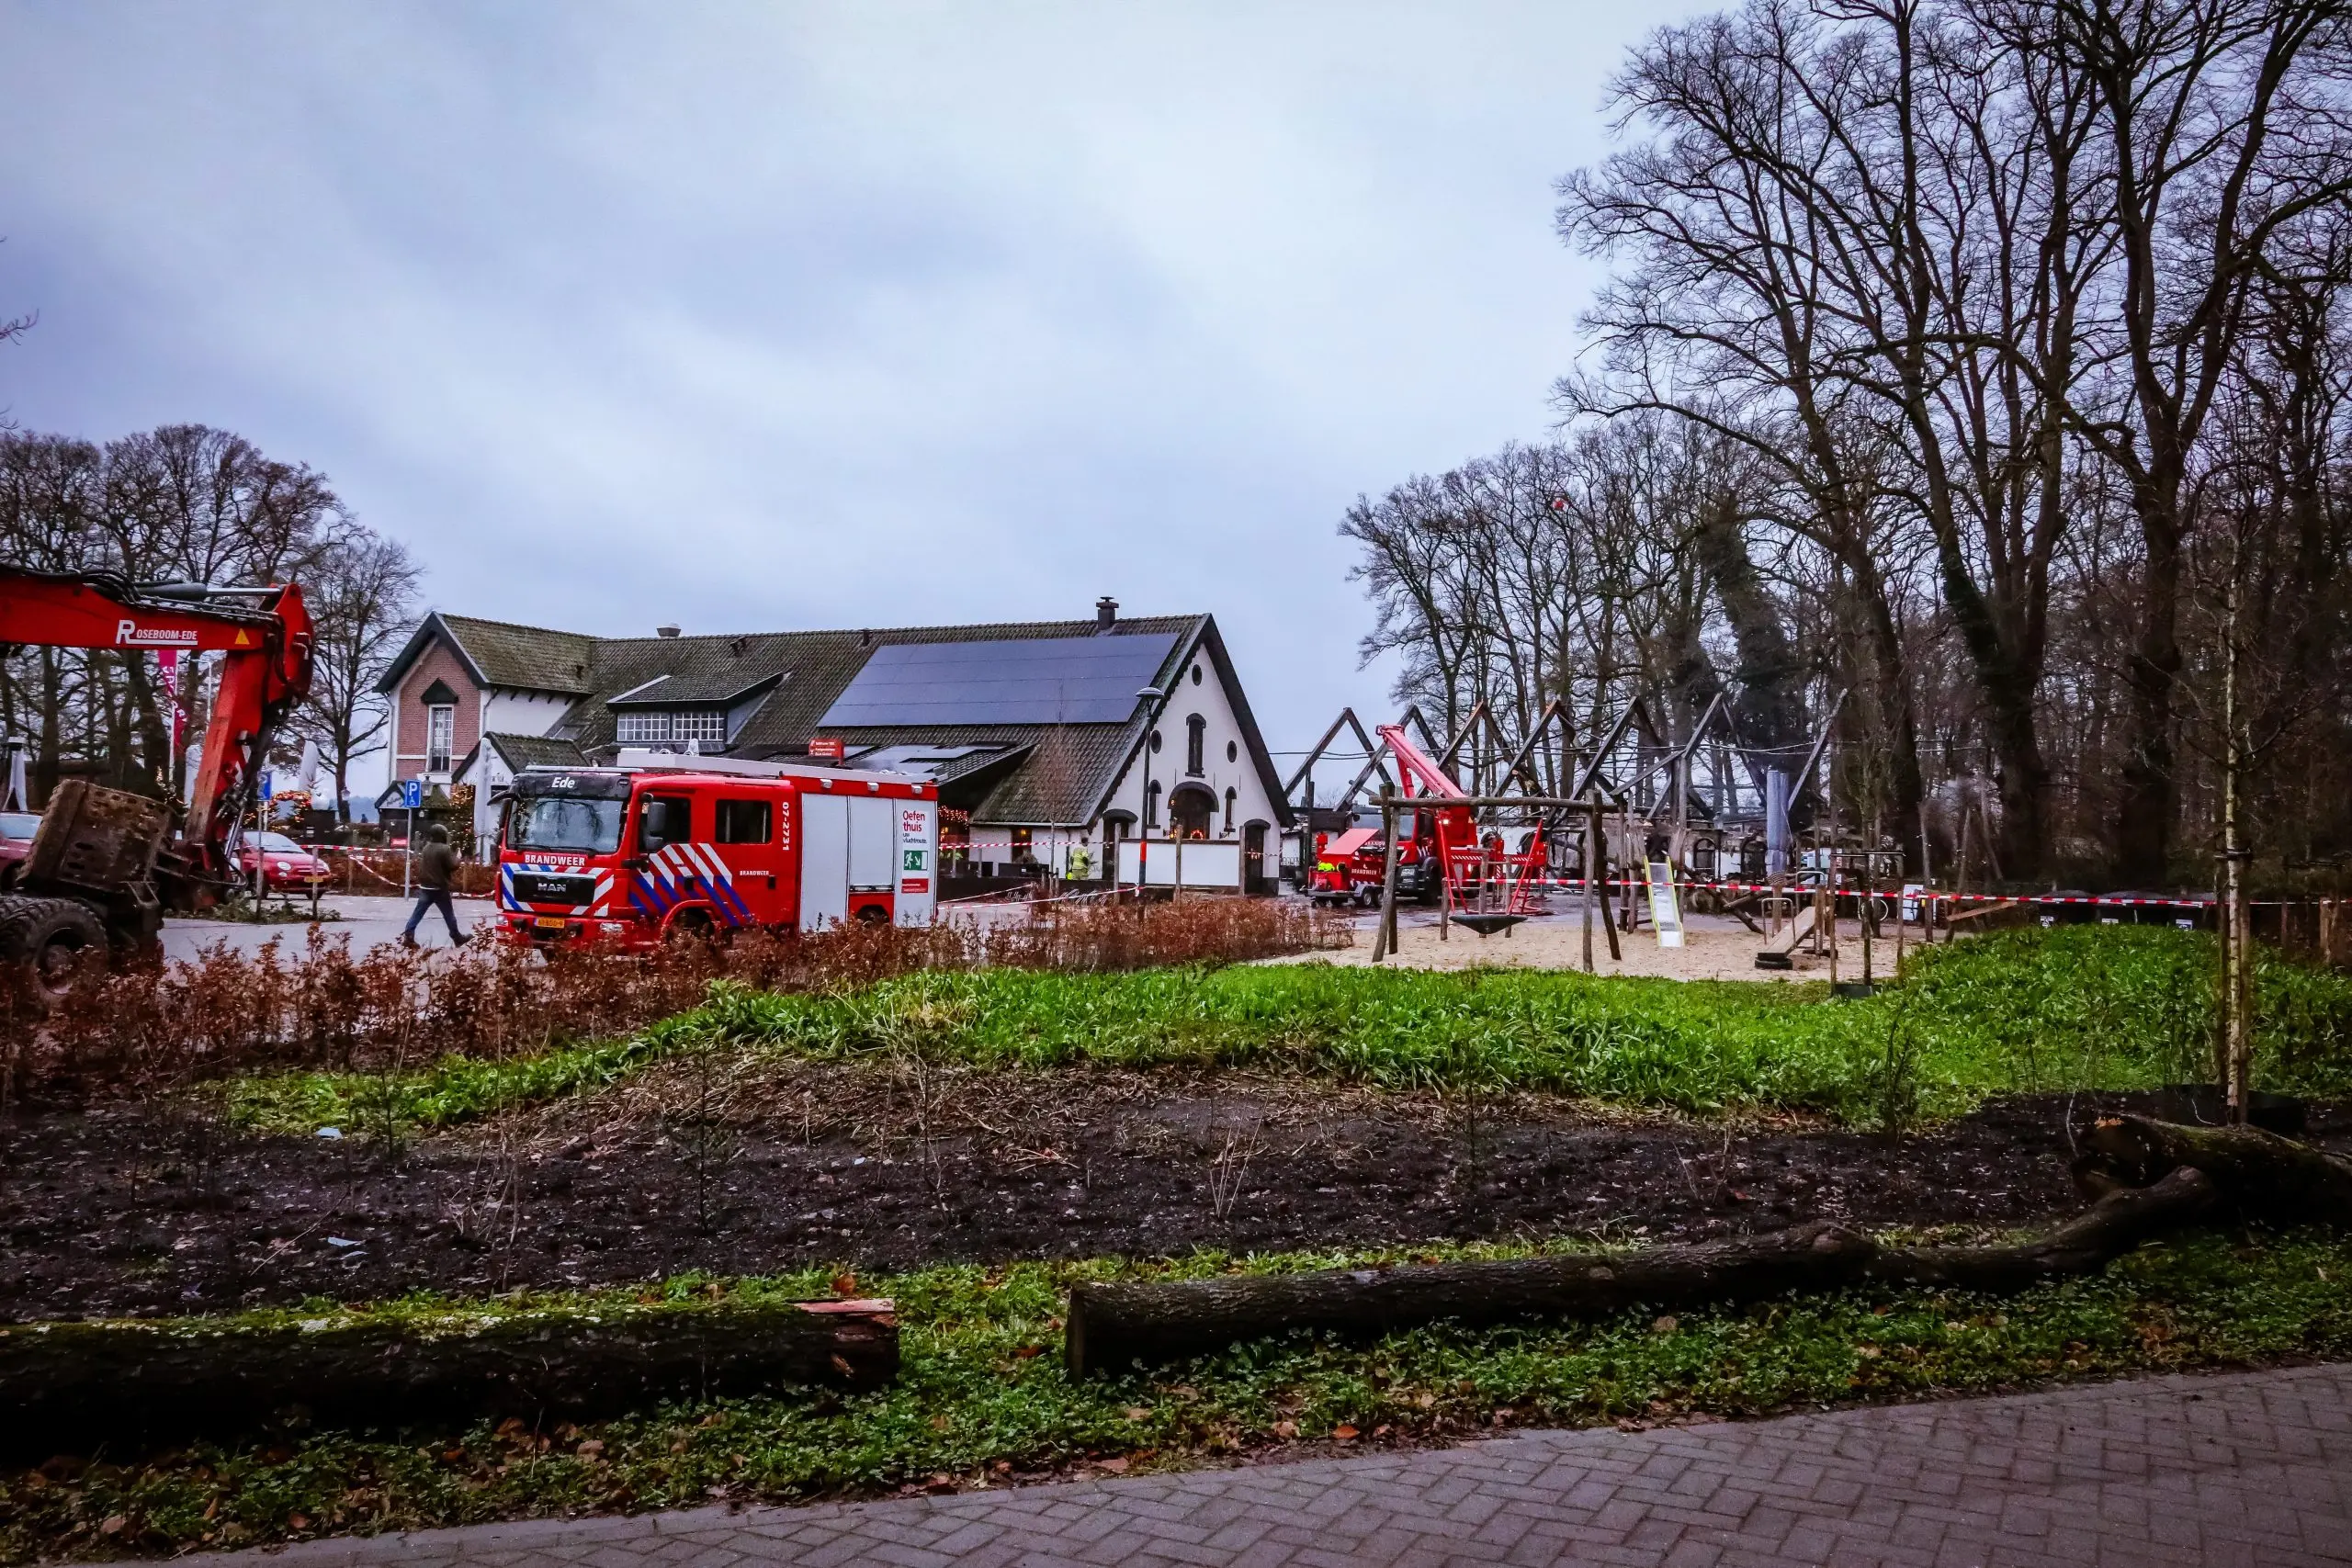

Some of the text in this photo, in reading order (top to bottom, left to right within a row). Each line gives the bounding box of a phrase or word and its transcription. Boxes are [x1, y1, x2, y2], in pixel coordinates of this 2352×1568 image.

[116, 619, 198, 645] ROSEBOOM-EDE
[551, 776, 575, 788] Ede
[409, 783, 418, 795] P
[902, 809, 926, 821] Oefen
[782, 801, 790, 851] 07-2731
[902, 820, 922, 832] thuis
[525, 854, 585, 866] BRANDWEER
[537, 883, 567, 893] MAN
